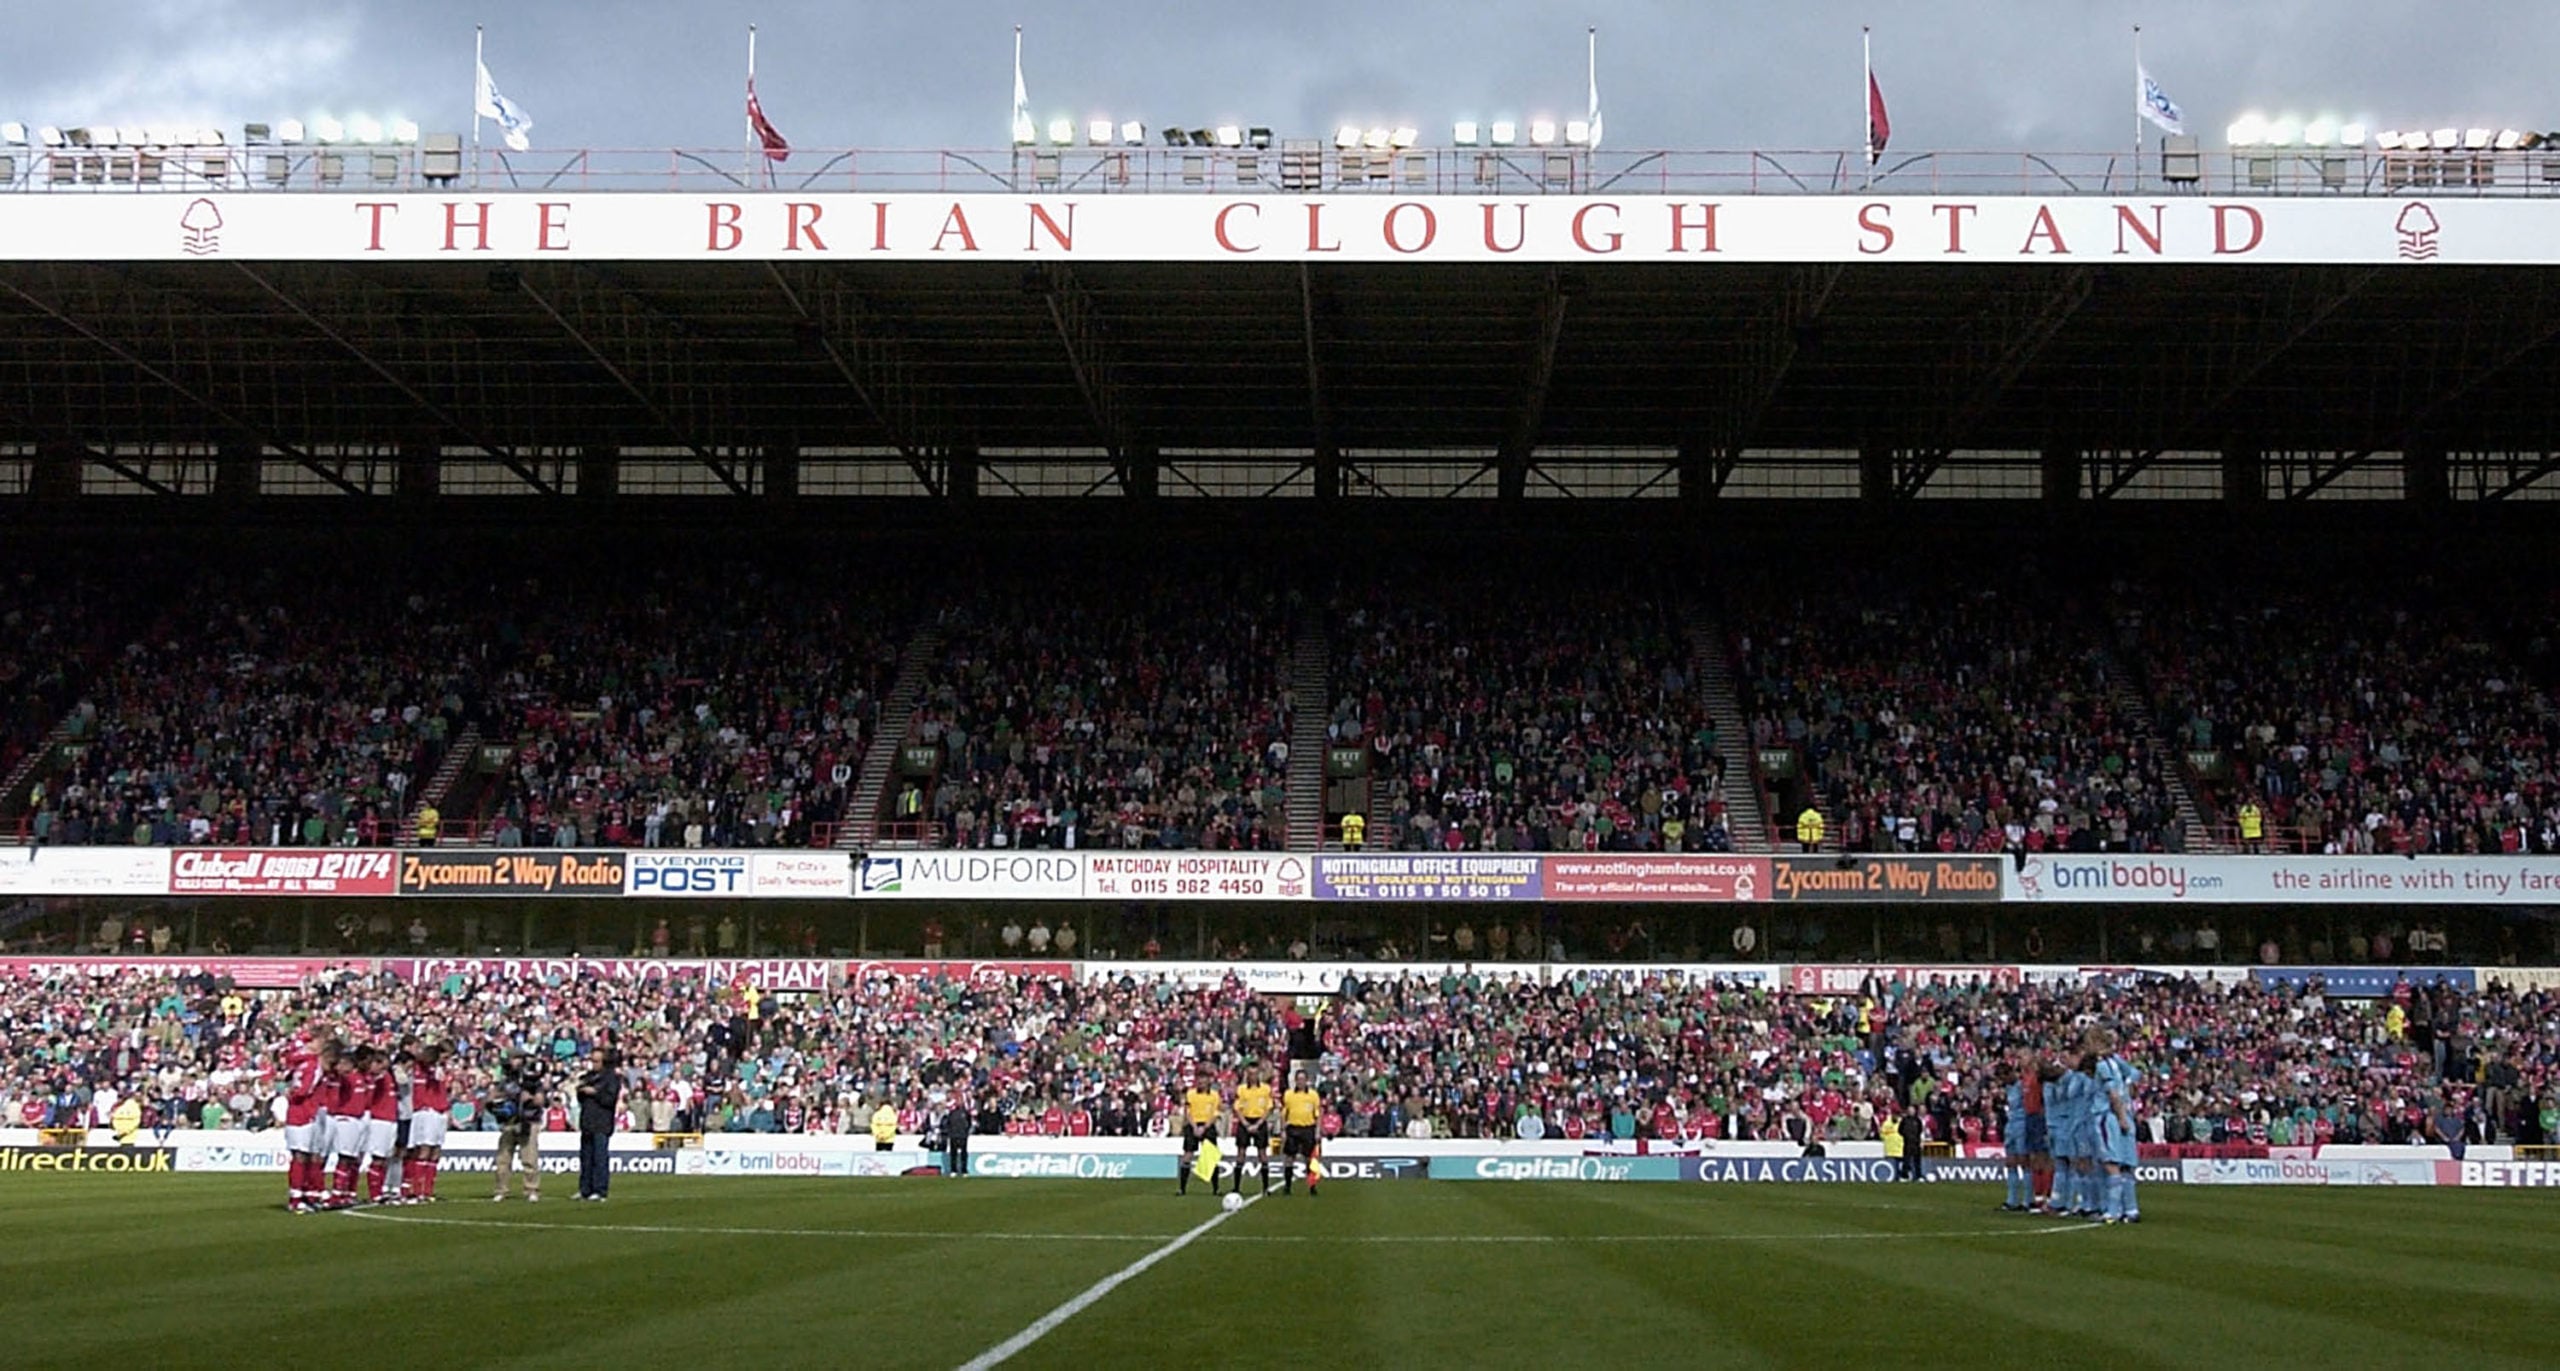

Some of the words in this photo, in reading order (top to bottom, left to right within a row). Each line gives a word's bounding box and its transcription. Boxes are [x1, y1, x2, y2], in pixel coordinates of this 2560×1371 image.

[355, 202, 571, 251] THE
[705, 202, 1078, 252] BRIAN
[1214, 202, 1723, 253] CLOUGH
[1857, 203, 2265, 255] STAND
[1332, 751, 1361, 761] EXIT
[1759, 752, 1788, 762] EXIT
[175, 851, 263, 878] Clubcall
[634, 857, 745, 867] EVENING
[910, 857, 1077, 882] MUDFORD
[1092, 859, 1171, 875] MATCHDAY
[1178, 860, 1270, 876] HOSPITALITY
[1321, 859, 1410, 875] NOTTINGHAM
[1412, 859, 1459, 875] OFFICE
[1460, 859, 1538, 876] EQUIPMENT
[1555, 862, 1756, 880] www.nottinghamforest.co.uk
[403, 857, 491, 891] Zycomm
[494, 857, 511, 883] 2
[512, 857, 556, 891] Way
[560, 856, 623, 884] Radio
[633, 867, 744, 891] POST
[1776, 863, 1864, 899] Zycomm
[1867, 863, 1883, 889] 2
[1886, 863, 1930, 897] Way
[1936, 862, 1996, 890] Radio
[2273, 869, 2310, 889] the
[2319, 869, 2393, 890] airline
[2401, 868, 2453, 889] with
[2465, 868, 2512, 896] tiny
[1131, 880, 1168, 894] 0115
[1176, 880, 1211, 894] 982
[1218, 880, 1263, 894] 4450
[1334, 886, 1370, 898] TEL:
[1377, 886, 1417, 898] 0115
[1423, 886, 1434, 898] 9
[1441, 886, 1462, 898] 50
[1495, 886, 1511, 898] 15
[1699, 1160, 1779, 1182] GALA
[1782, 1160, 1895, 1182] CASINO
